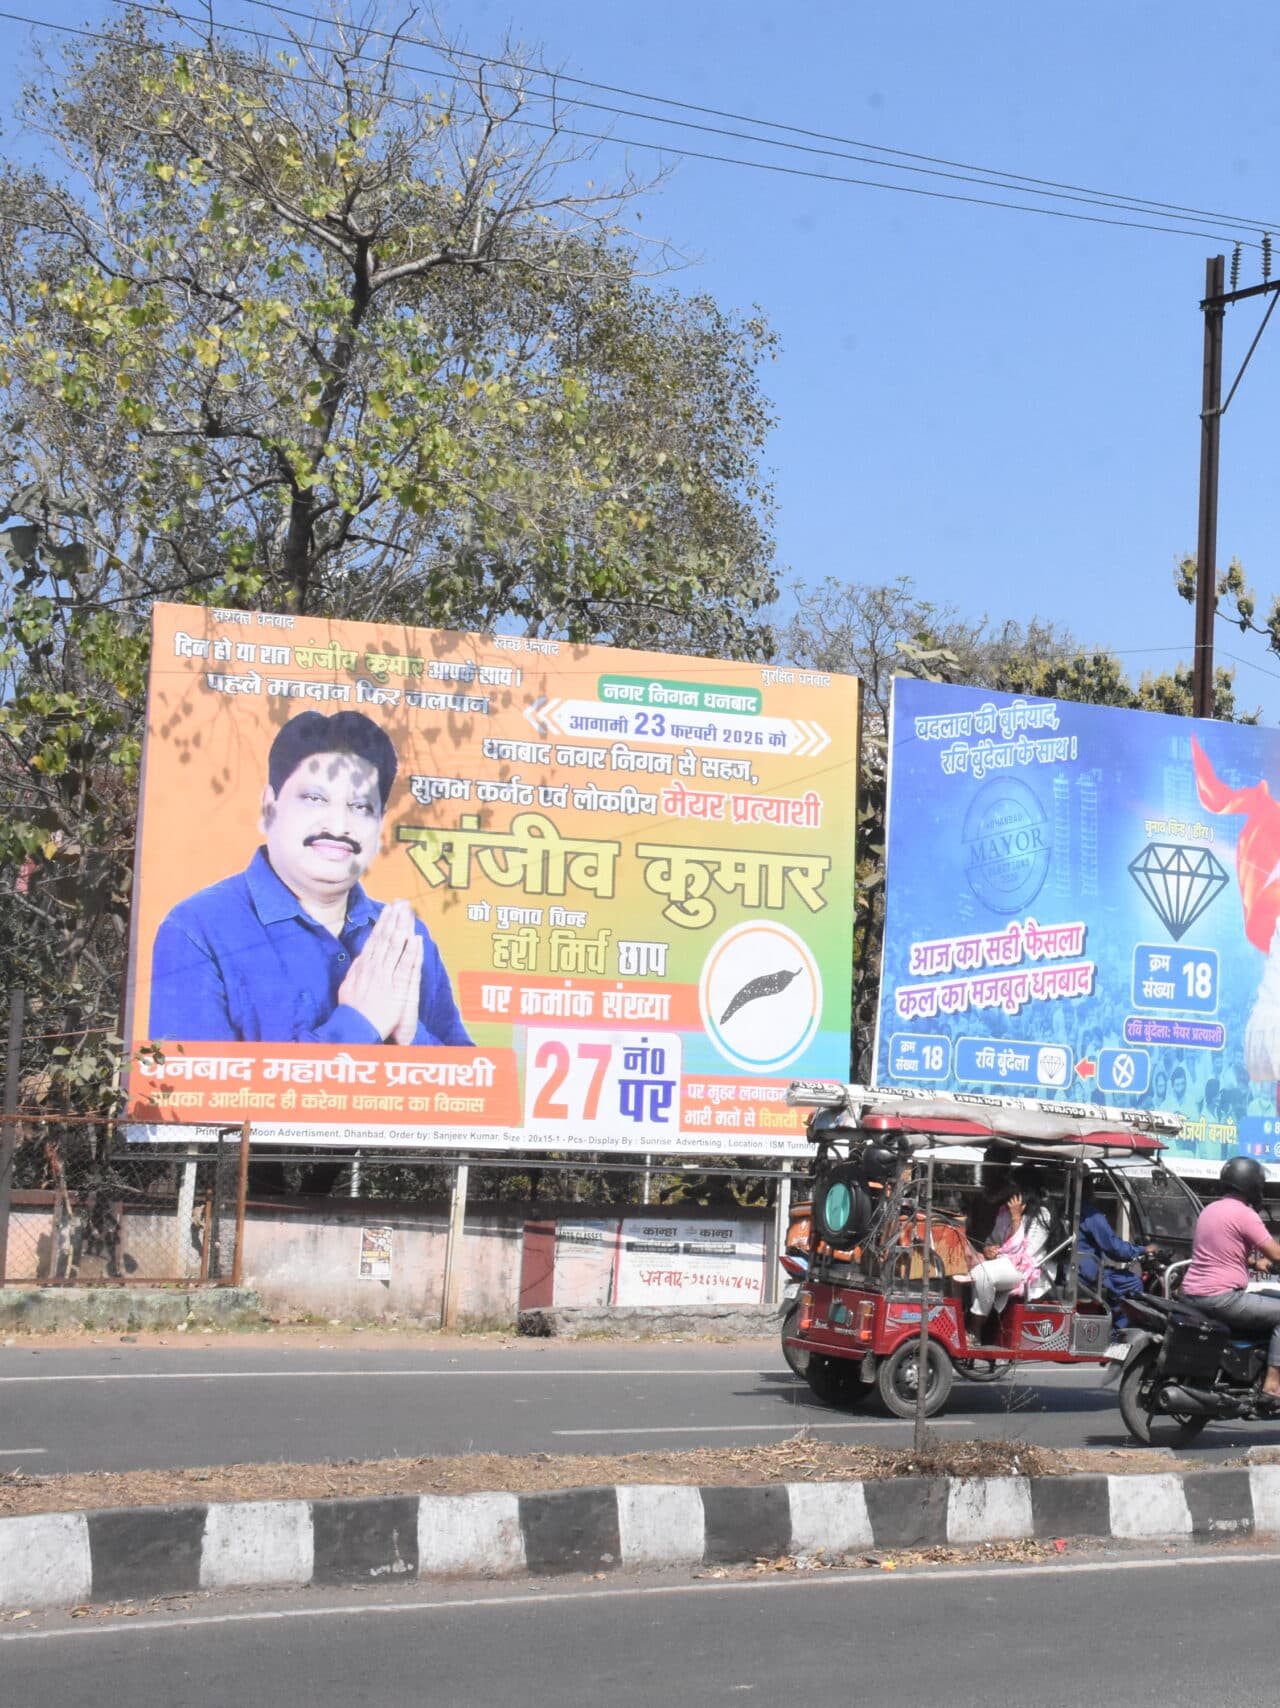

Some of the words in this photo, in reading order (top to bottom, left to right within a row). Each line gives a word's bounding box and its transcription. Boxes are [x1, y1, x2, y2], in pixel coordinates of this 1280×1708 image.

[213, 609, 252, 625] सशक्त
[174, 631, 210, 658] दिन
[214, 636, 232, 661] हो
[237, 643, 257, 663] या
[260, 645, 291, 665] रात
[294, 638, 359, 671] संजीव
[365, 651, 425, 683] कुमार
[207, 671, 263, 694] पहले
[267, 678, 351, 702] मतदान
[356, 679, 400, 706] फिर
[405, 690, 490, 714] जलपान
[603, 683, 644, 702] नगर
[648, 682, 698, 707] निगम
[703, 693, 757, 712] धनबाद
[569, 714, 628, 734] आगामी
[634, 712, 665, 736] 23
[671, 723, 717, 742] फरवरी
[768, 731, 787, 747] को
[915, 712, 972, 740] बदलाव
[975, 703, 997, 736] की
[482, 738, 551, 765] धनबाद
[556, 744, 607, 769] नगर
[611, 743, 672, 774] निगम
[677, 749, 696, 777] से
[702, 757, 759, 785] सहज,
[941, 742, 969, 774] रवि
[1017, 735, 1033, 763] के
[410, 774, 472, 805] सुलभ
[476, 775, 534, 804] कर्मठ
[537, 784, 569, 809] एवं
[573, 783, 658, 815] लोकप्रिय
[662, 782, 727, 820] मेयर
[732, 790, 822, 827] प्रत्याशी
[970, 827, 1044, 864] MAYOR
[397, 812, 621, 899] संजीव
[636, 841, 832, 929] कुमार
[467, 901, 490, 921] को
[496, 906, 543, 929] चुनाव
[549, 906, 588, 929] चिन्ह
[491, 928, 540, 972] हरी
[549, 928, 612, 975] मिर्च
[617, 940, 669, 977] छाप
[912, 942, 951, 971] आज
[956, 938, 981, 965] का
[986, 926, 1021, 961] सही
[1025, 921, 1083, 956] फैसला
[899, 987, 937, 1015] कल
[941, 982, 967, 1009] का
[972, 974, 1028, 1010] मजबूत
[1032, 965, 1091, 996] धनबाद
[1142, 977, 1175, 999] संख्या
[1183, 961, 1212, 998] 18
[481, 983, 511, 1014] पर
[520, 981, 594, 1018] क्रमांक
[602, 983, 671, 1021] संख्या
[1128, 1020, 1144, 1036] रवि
[263, 1052, 377, 1084] महापौर
[384, 1058, 495, 1087] प्रत्याशी
[922, 1045, 943, 1071] 18
[976, 1047, 995, 1069] रवि
[532, 1040, 612, 1121] 27
[687, 1083, 703, 1098] पर
[279, 1088, 296, 1110] ही
[302, 1090, 347, 1111] करेगा
[351, 1093, 404, 1112] धनबाद
[408, 1094, 430, 1112] का
[434, 1091, 485, 1113] विकास
[618, 1079, 677, 1123] पर
[250, 1128, 276, 1137] Moon
[389, 1130, 415, 1140] Order
[433, 1131, 468, 1142] Sanjeev
[503, 1132, 520, 1142] Size
[621, 1137, 634, 1147] By
[640, 1137, 672, 1146] Sunrise
[676, 1138, 722, 1149] Advertising
[729, 1140, 763, 1149] Location
[769, 1141, 785, 1149] ISM
[643, 1227, 678, 1237] कान्हा
[700, 1229, 733, 1239] कान्हा
